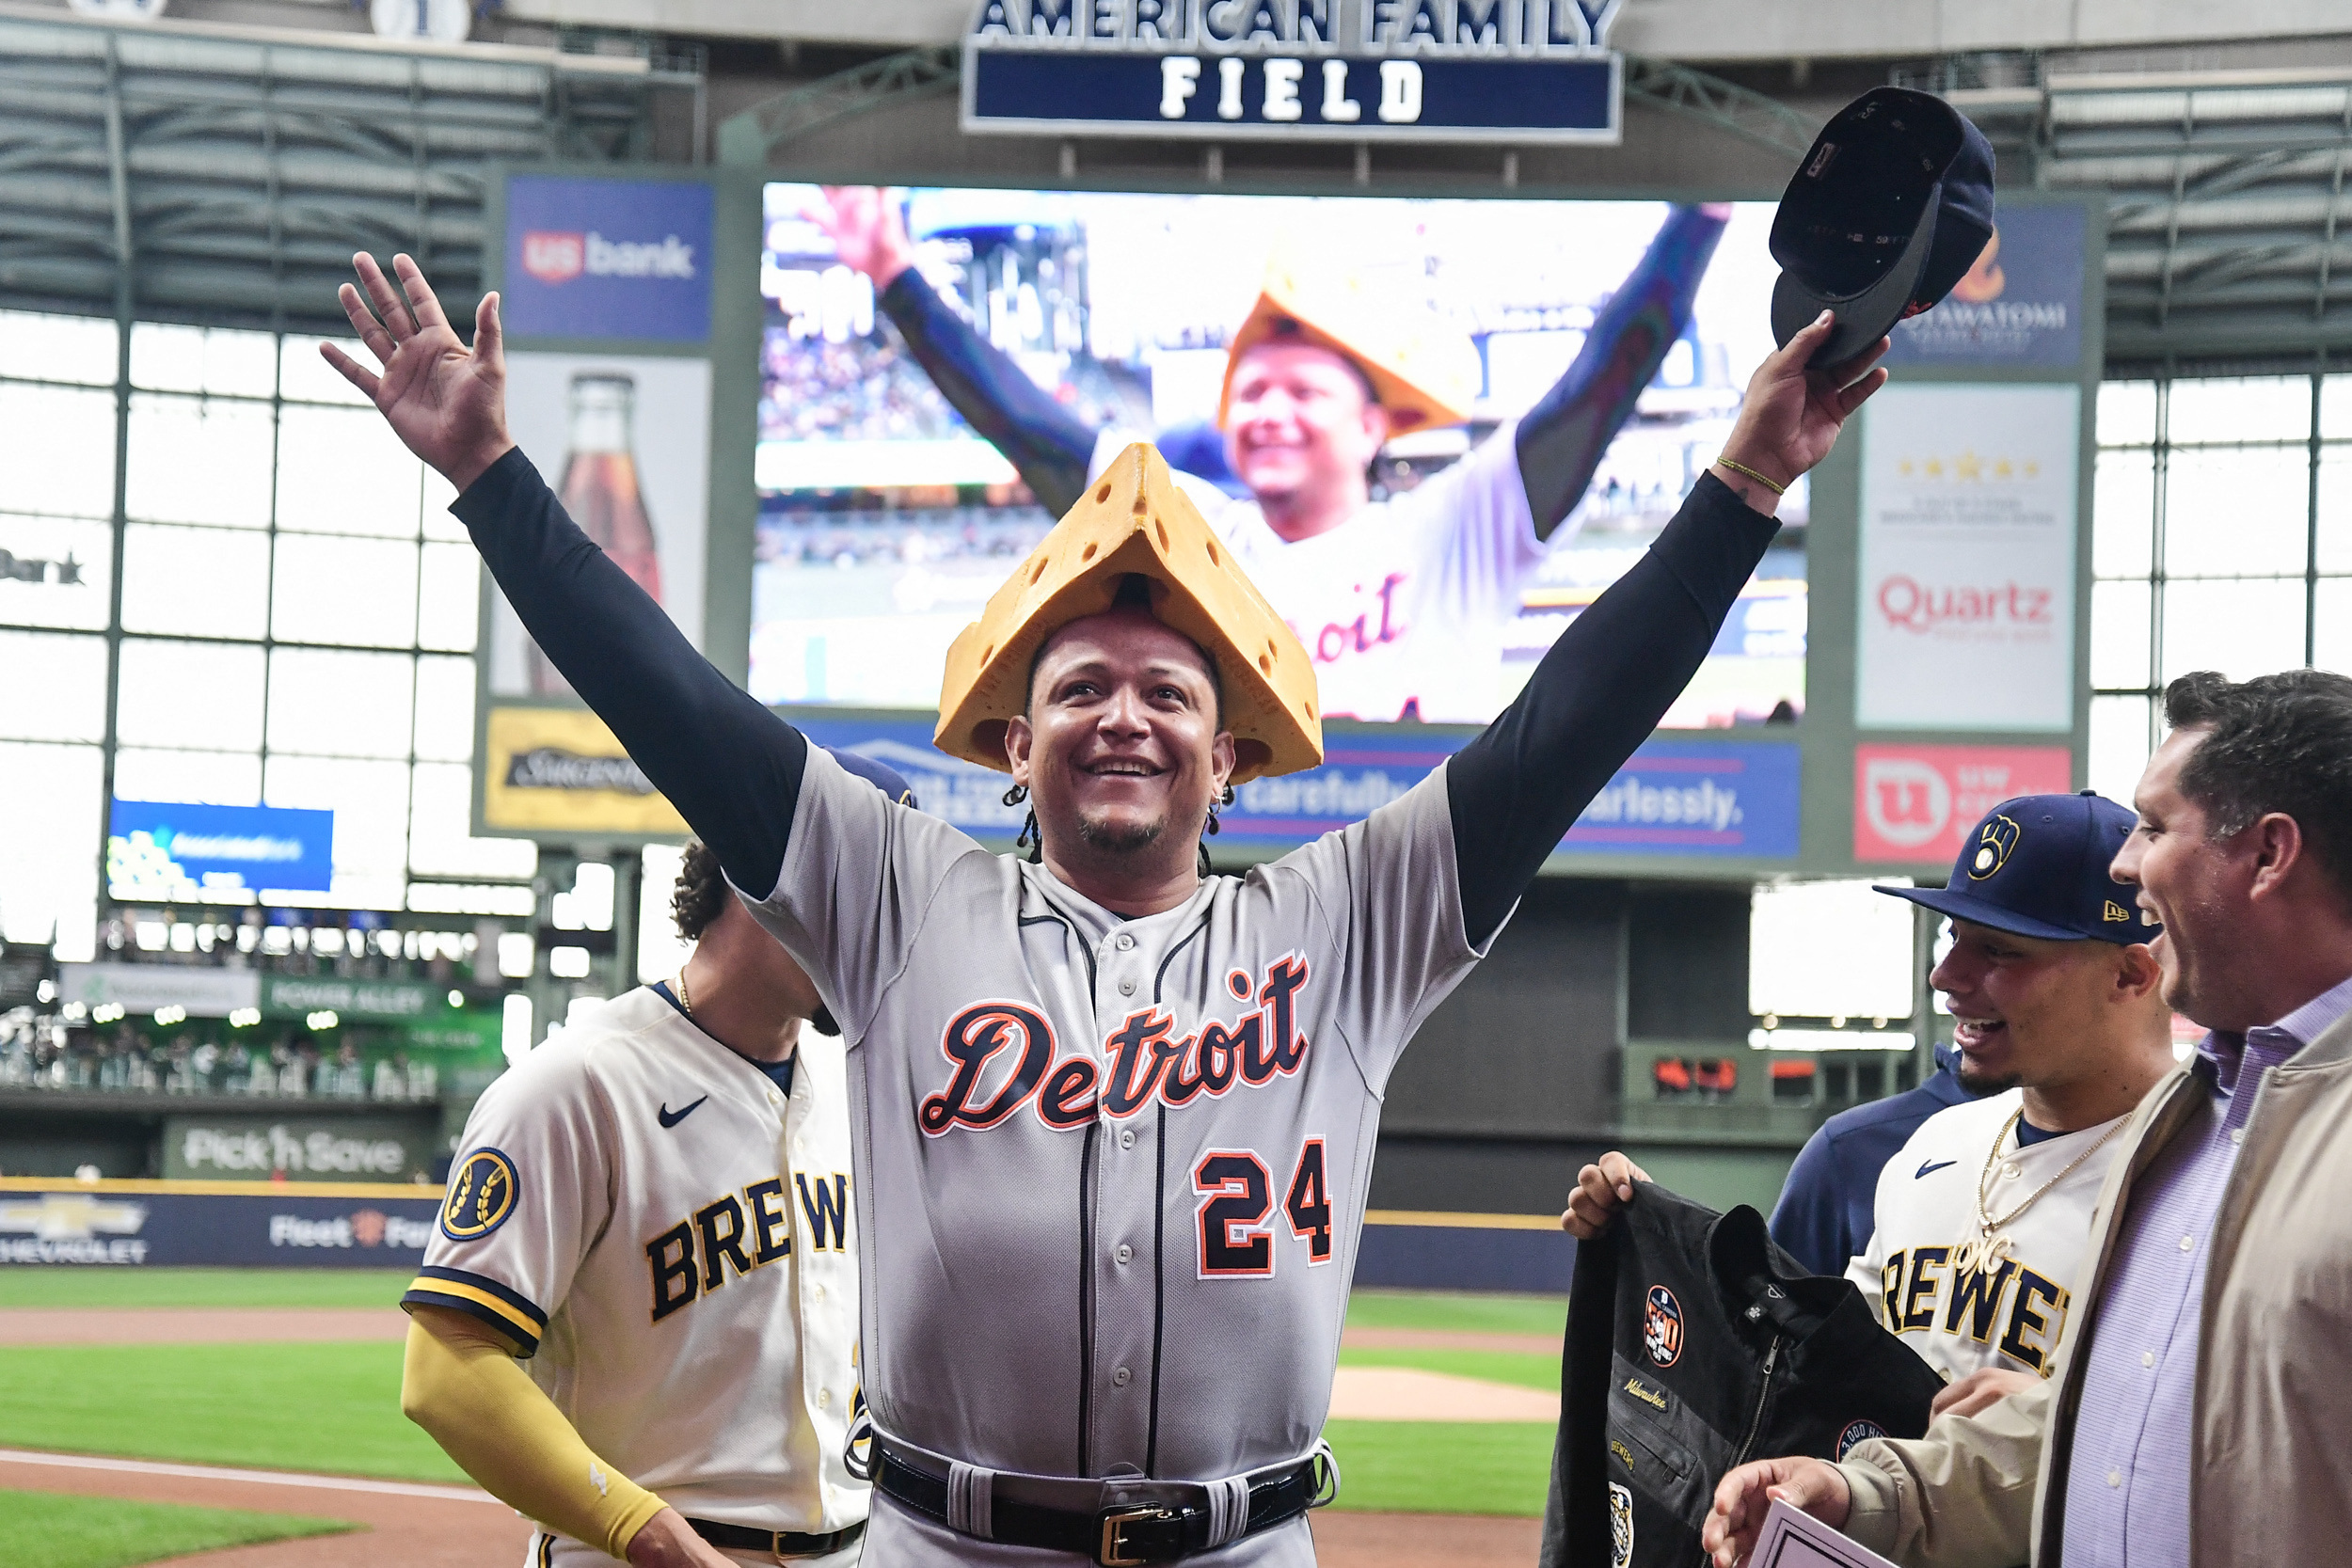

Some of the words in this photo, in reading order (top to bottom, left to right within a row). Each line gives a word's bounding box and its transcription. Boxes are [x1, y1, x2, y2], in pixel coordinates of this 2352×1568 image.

[969, 0, 1343, 54] AMERICAN
[1361, 0, 1624, 57] FAMILY
[1160, 56, 1422, 122] FIELD
[585, 230, 694, 278] bank
[1878, 573, 2054, 636] Quartz
[1577, 775, 1744, 832] arlessly.
[919, 948, 1309, 1138] Detroit
[269, 1214, 354, 1248] Fleet
[1190, 1134, 1333, 1280] 24
[1624, 1378, 1666, 1408] Milwaukee
[1841, 1424, 1867, 1451] 3,000
[1868, 1426, 1884, 1439] HI
